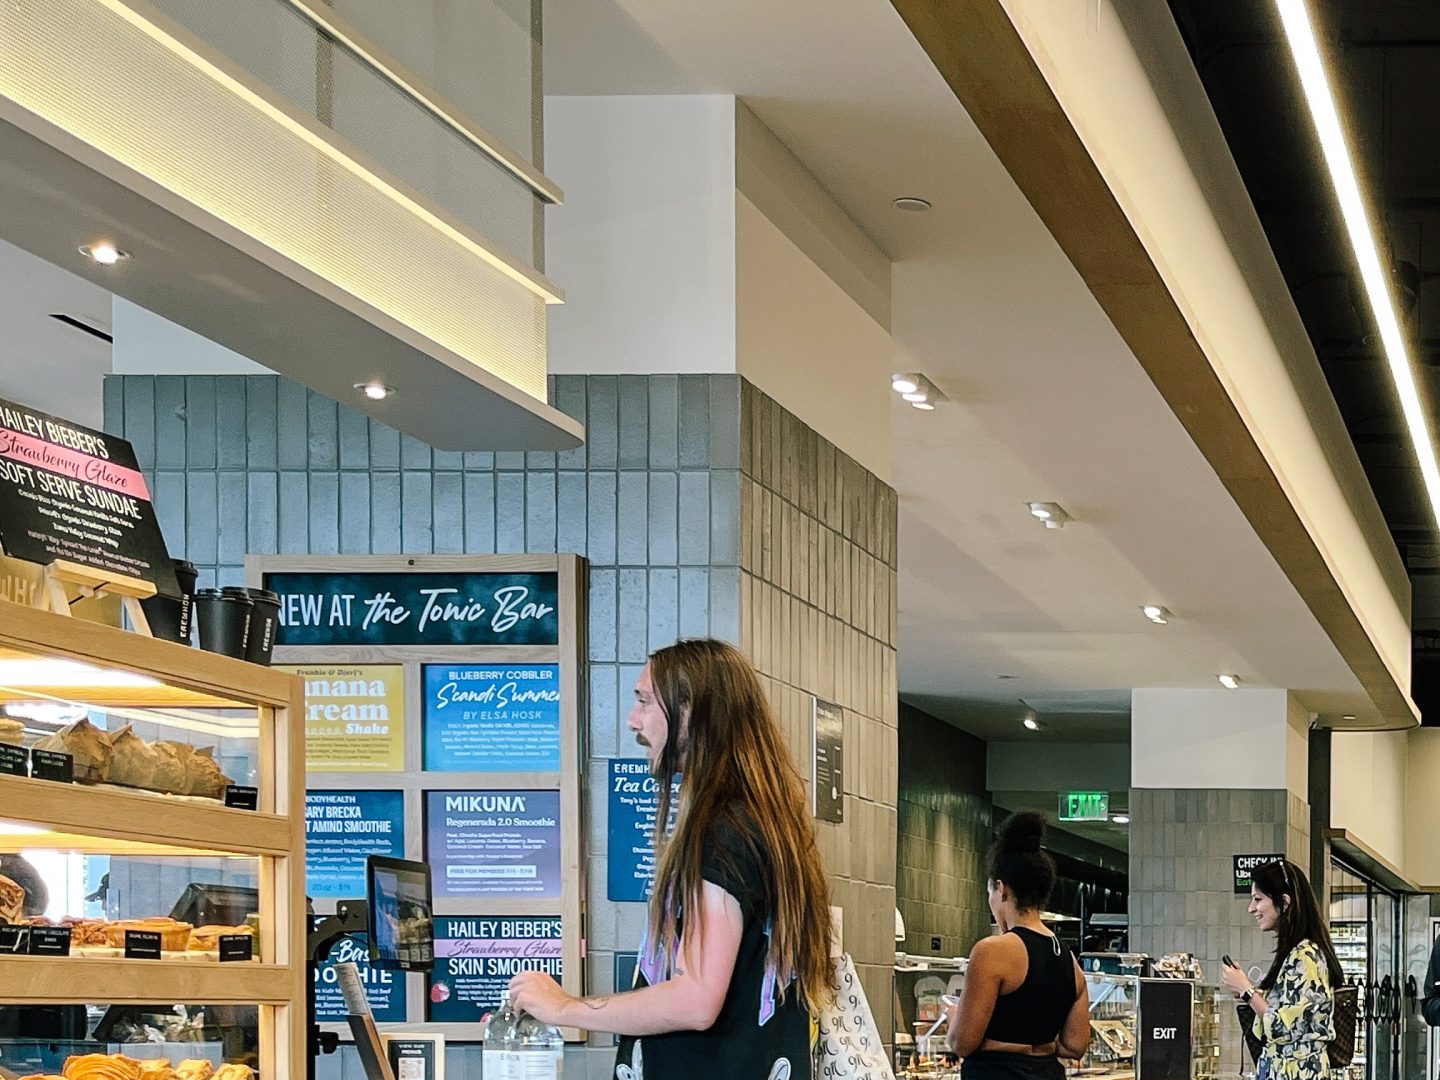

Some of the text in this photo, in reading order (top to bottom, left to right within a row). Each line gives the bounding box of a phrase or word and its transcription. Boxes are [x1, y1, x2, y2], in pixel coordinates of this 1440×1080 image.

[47, 422, 109, 459] BIEBER'S
[0, 430, 128, 488] Strawberry Glaze
[0, 459, 143, 520] SOFT SERVE SUNDAE
[277, 585, 553, 632] NEW AT the Tonic Bar
[448, 671, 553, 680] BLUEBERRY COBBLER
[305, 679, 386, 697] nana
[437, 682, 496, 709] Scandi
[305, 700, 389, 720] ream
[463, 711, 543, 720] BY ELSA HOSK
[345, 723, 389, 734] Shake
[614, 763, 650, 774] EREWH
[614, 777, 640, 792] Tea
[326, 806, 362, 818] BRECKA
[446, 796, 526, 812] MIKUNA
[1069, 795, 1101, 817] EXIT
[312, 821, 391, 832] AMINO SMOOTHIE
[498, 818, 512, 826] 2.0
[513, 818, 555, 827] Smoothie
[448, 921, 562, 938] HAILEY BIEBER'S
[447, 940, 521, 957] Strawberry
[448, 958, 484, 975] SKIN
[1153, 1027, 1177, 1040] EXIT
